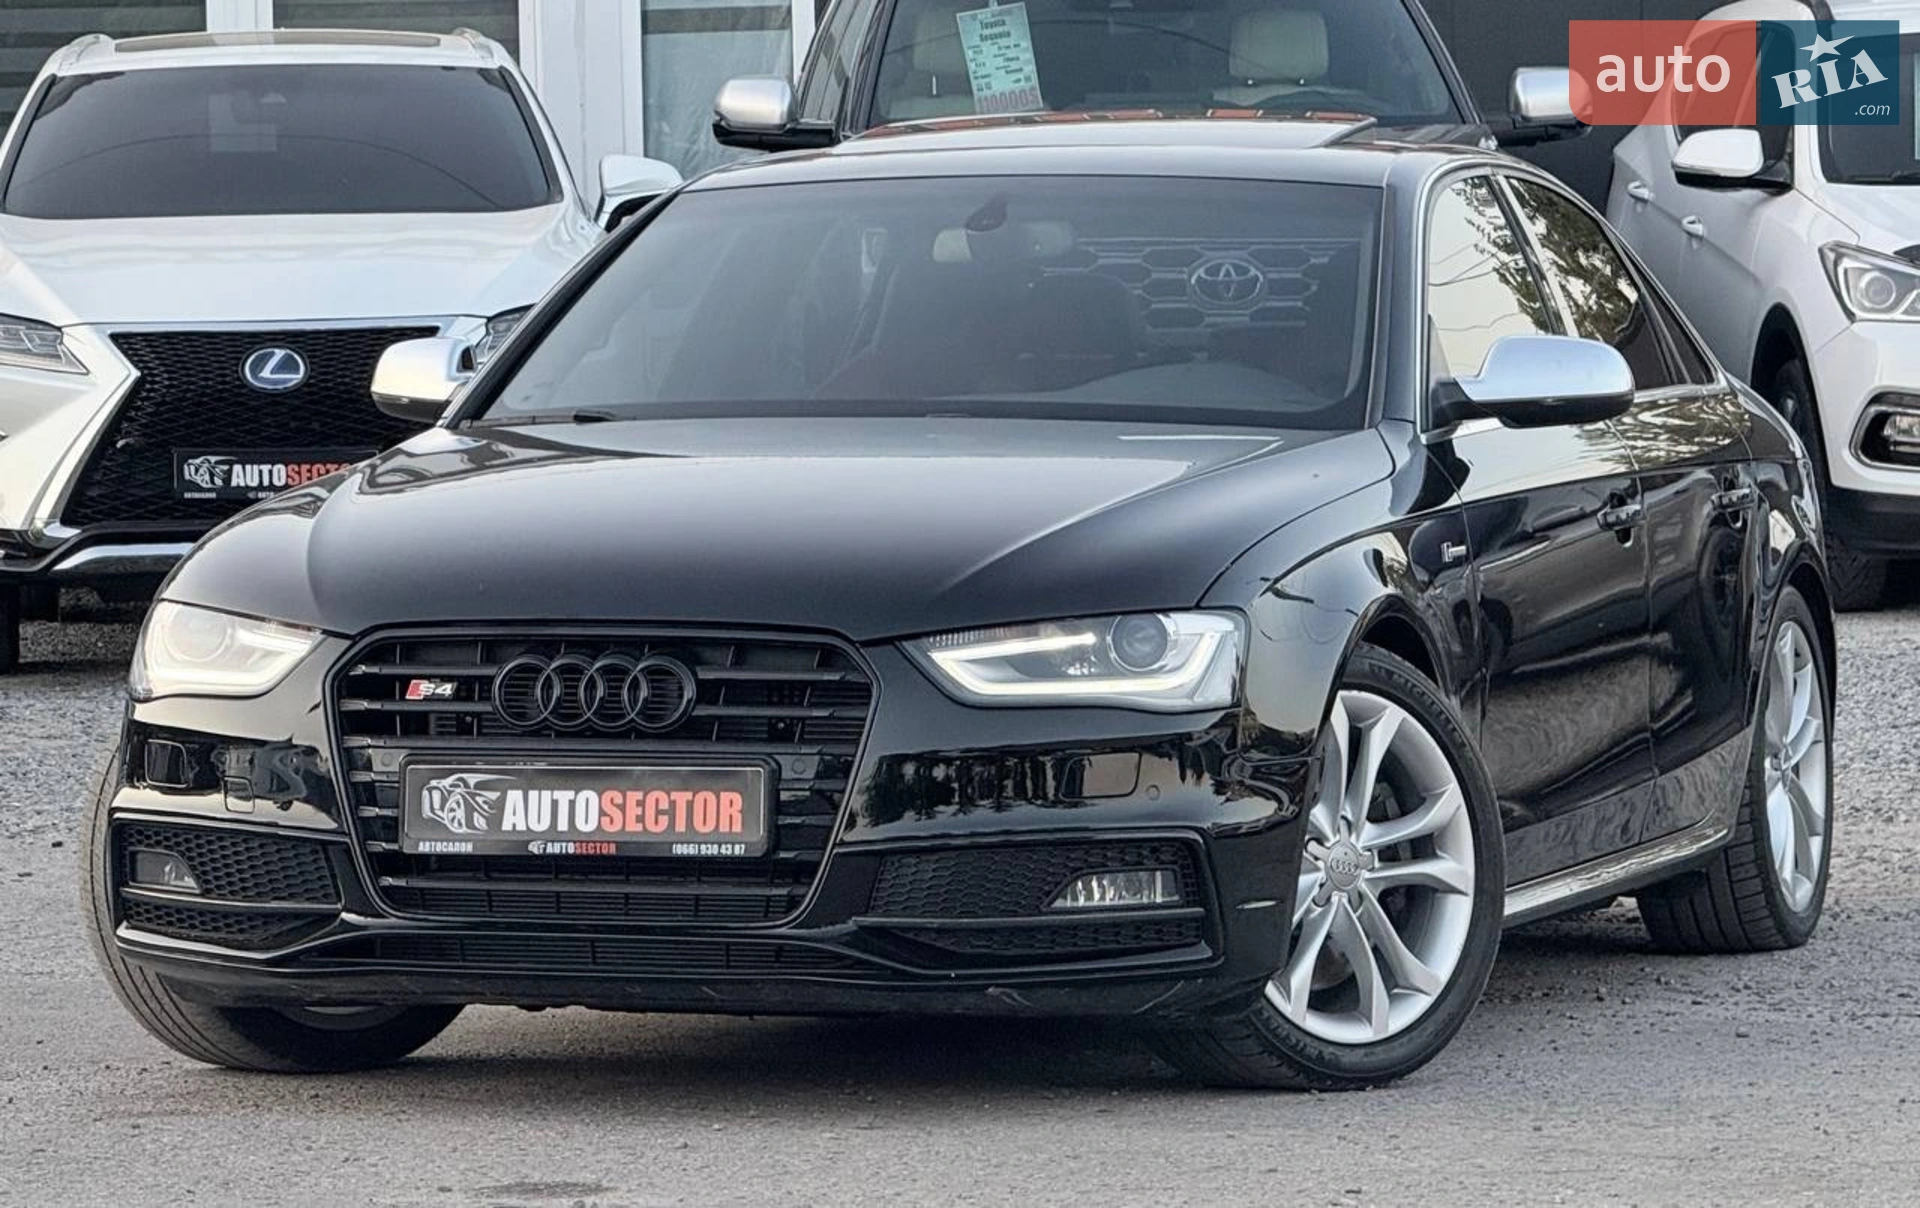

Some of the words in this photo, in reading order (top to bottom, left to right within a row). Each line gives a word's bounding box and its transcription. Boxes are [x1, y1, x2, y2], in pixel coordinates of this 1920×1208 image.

[408, 680, 455, 699] S4
[502, 790, 744, 833] AUTOSECTOR
[545, 842, 617, 855] AUTOSECTOR
[672, 843, 698, 855] (066)
[720, 843, 732, 855] 43
